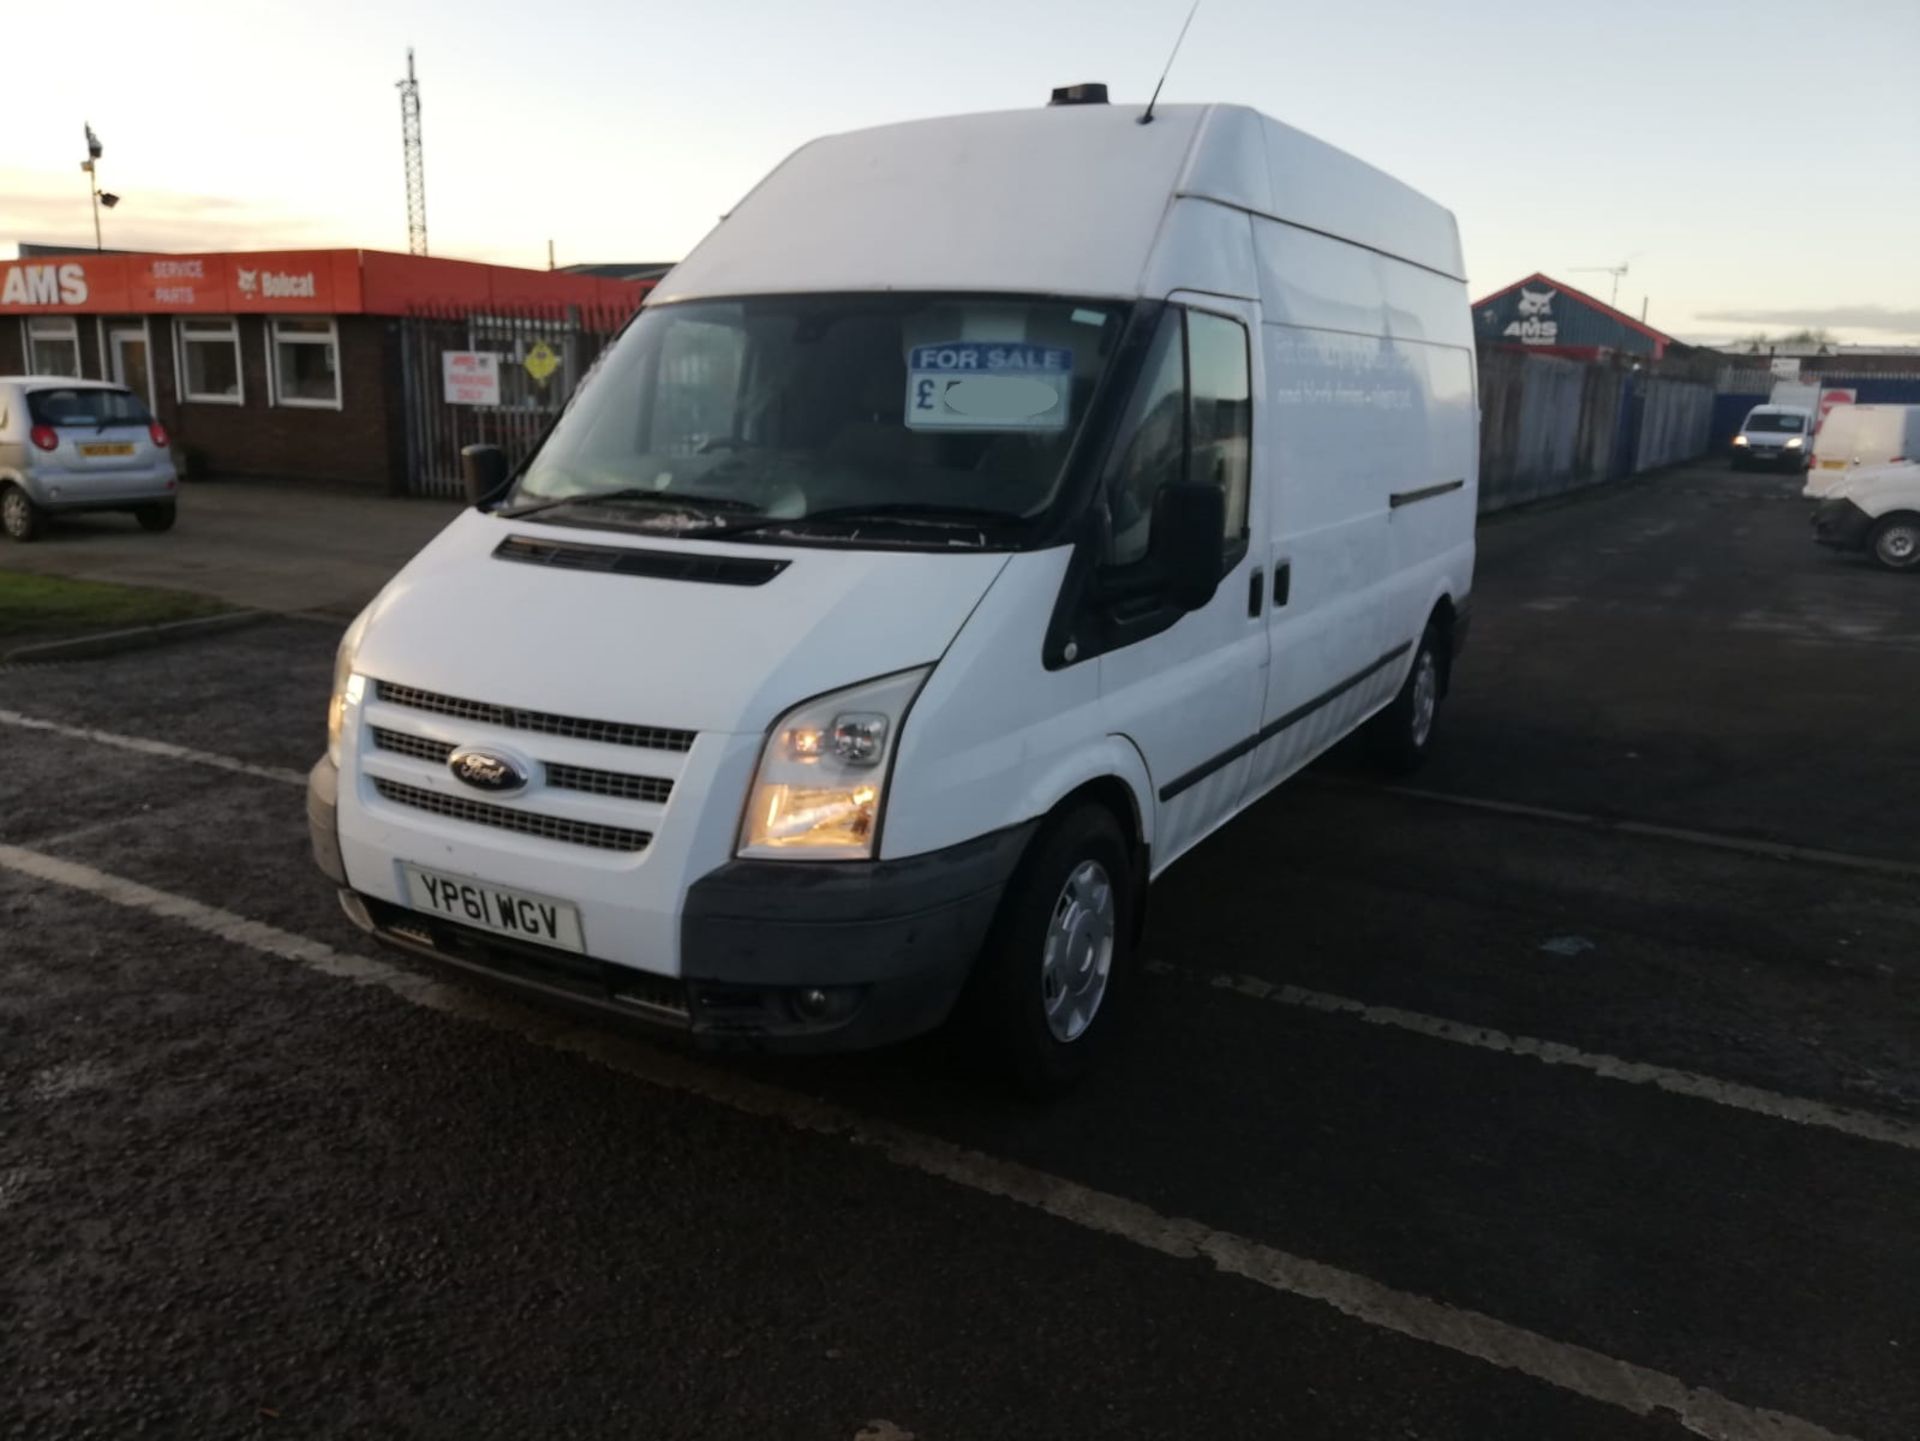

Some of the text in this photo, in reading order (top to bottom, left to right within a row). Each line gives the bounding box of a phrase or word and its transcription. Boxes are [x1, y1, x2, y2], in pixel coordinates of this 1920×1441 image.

[152, 260, 204, 279] SERVICE
[2, 264, 88, 306] AMS
[262, 271, 315, 298] Bobcat
[154, 287, 195, 304] PARTS
[1503, 320, 1557, 336] AMS
[920, 350, 1061, 369] FOR SALE
[421, 874, 557, 940] YP61 WGV
